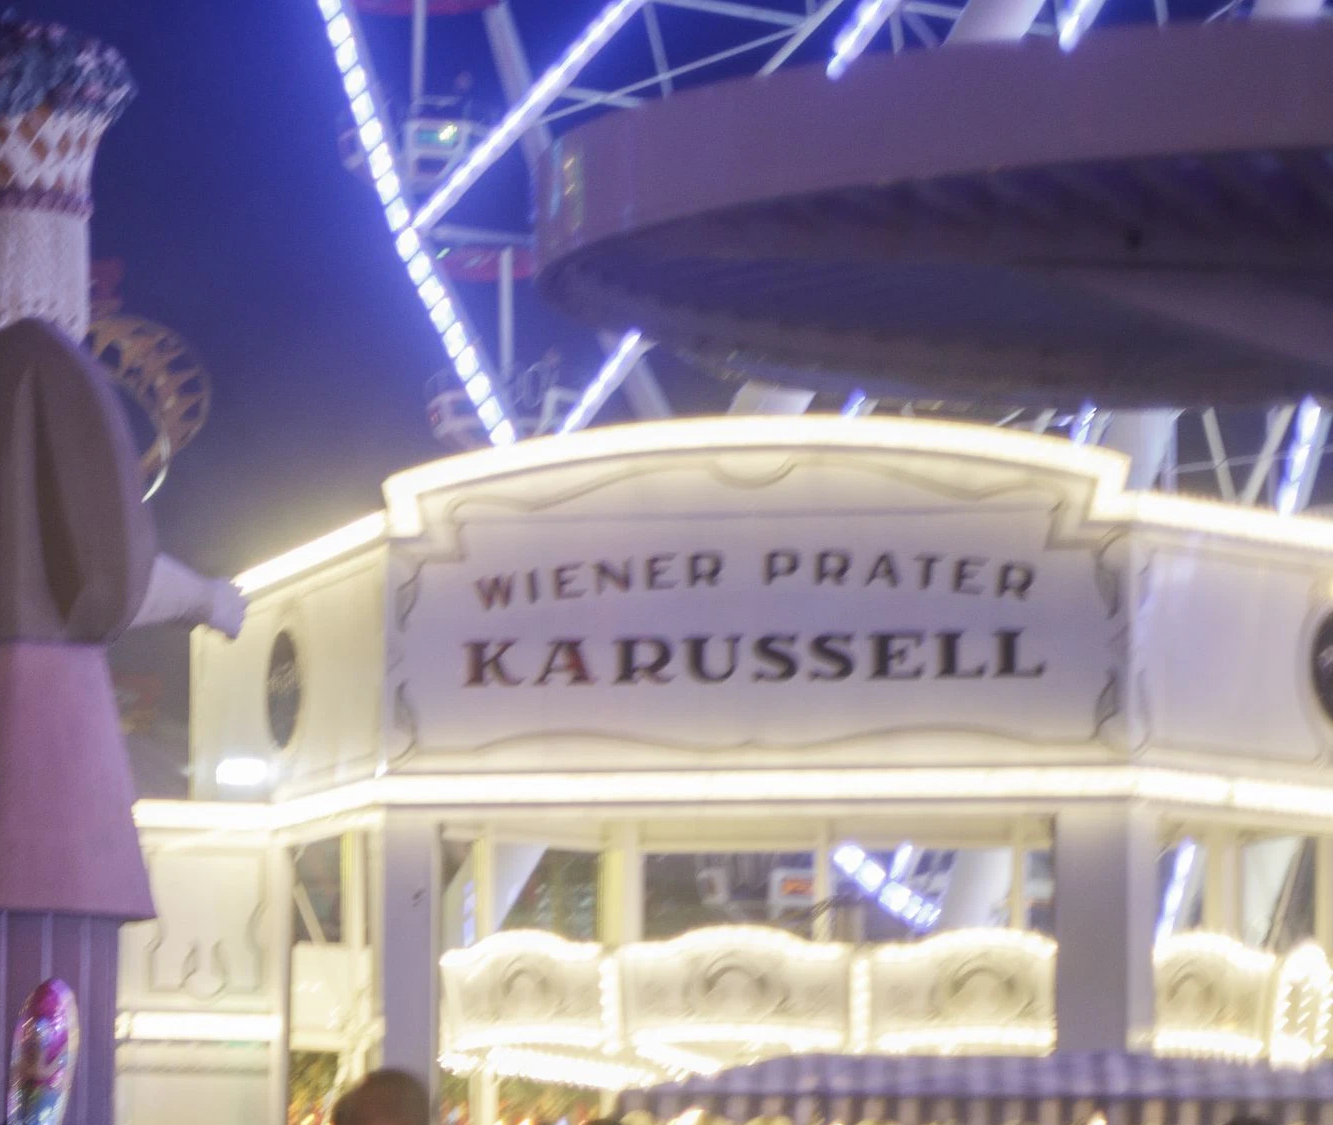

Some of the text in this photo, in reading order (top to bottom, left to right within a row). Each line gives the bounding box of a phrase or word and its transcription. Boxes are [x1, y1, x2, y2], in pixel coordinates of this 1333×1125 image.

[474, 549, 1037, 610] WIENER PRATER
[462, 629, 1046, 687] KARUSSELL
